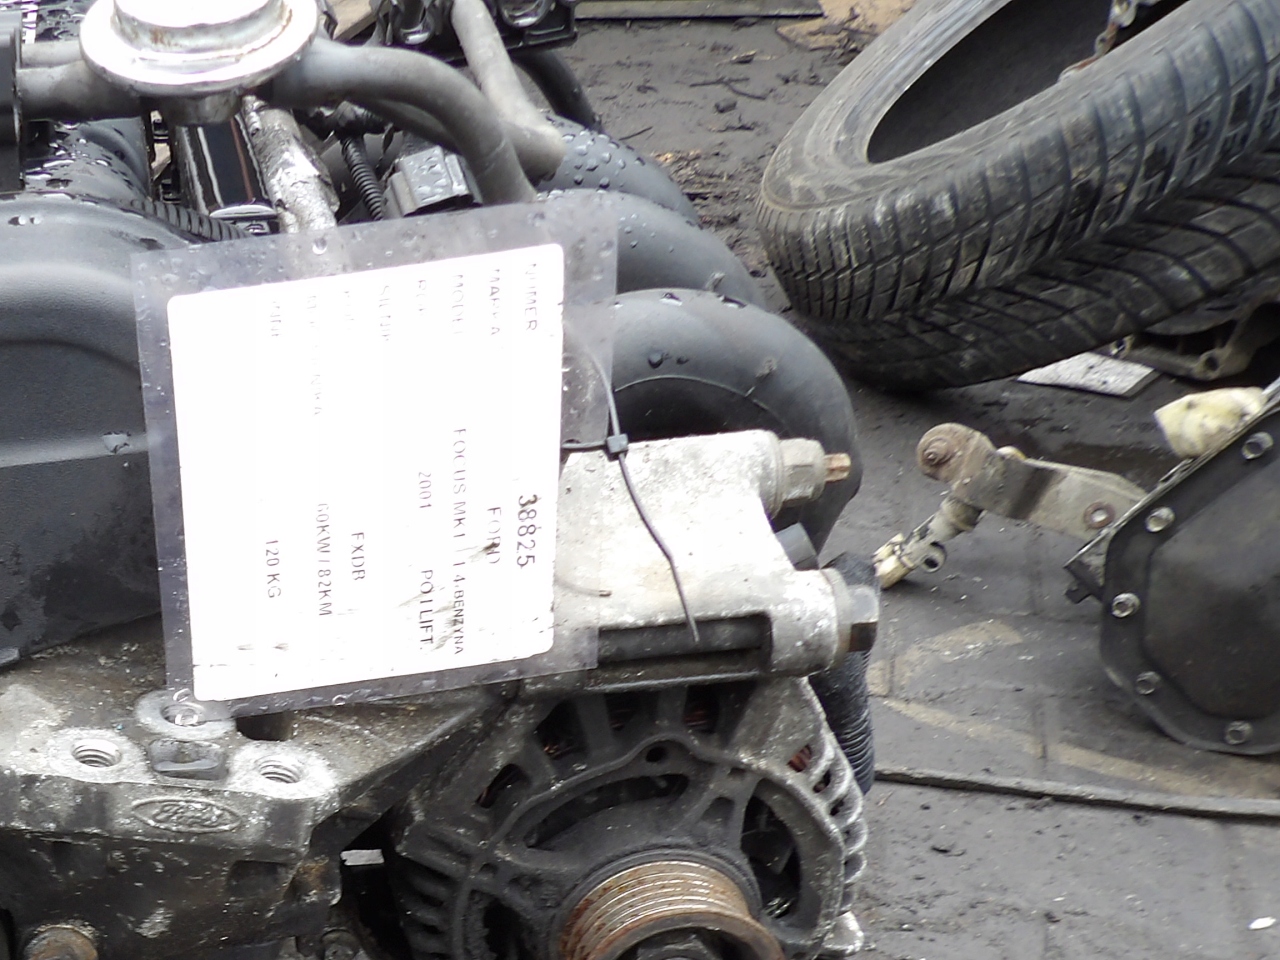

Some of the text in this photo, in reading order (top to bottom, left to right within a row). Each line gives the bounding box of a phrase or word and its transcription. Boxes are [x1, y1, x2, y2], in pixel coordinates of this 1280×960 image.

[418, 470, 432, 509] 2001
[452, 428, 466, 495] FOCUS
[452, 501, 466, 539] MK1
[486, 506, 502, 565] FORD
[516, 493, 539, 569] 38825
[265, 538, 282, 599] 120 KG
[454, 589, 465, 656] BENZYNA
